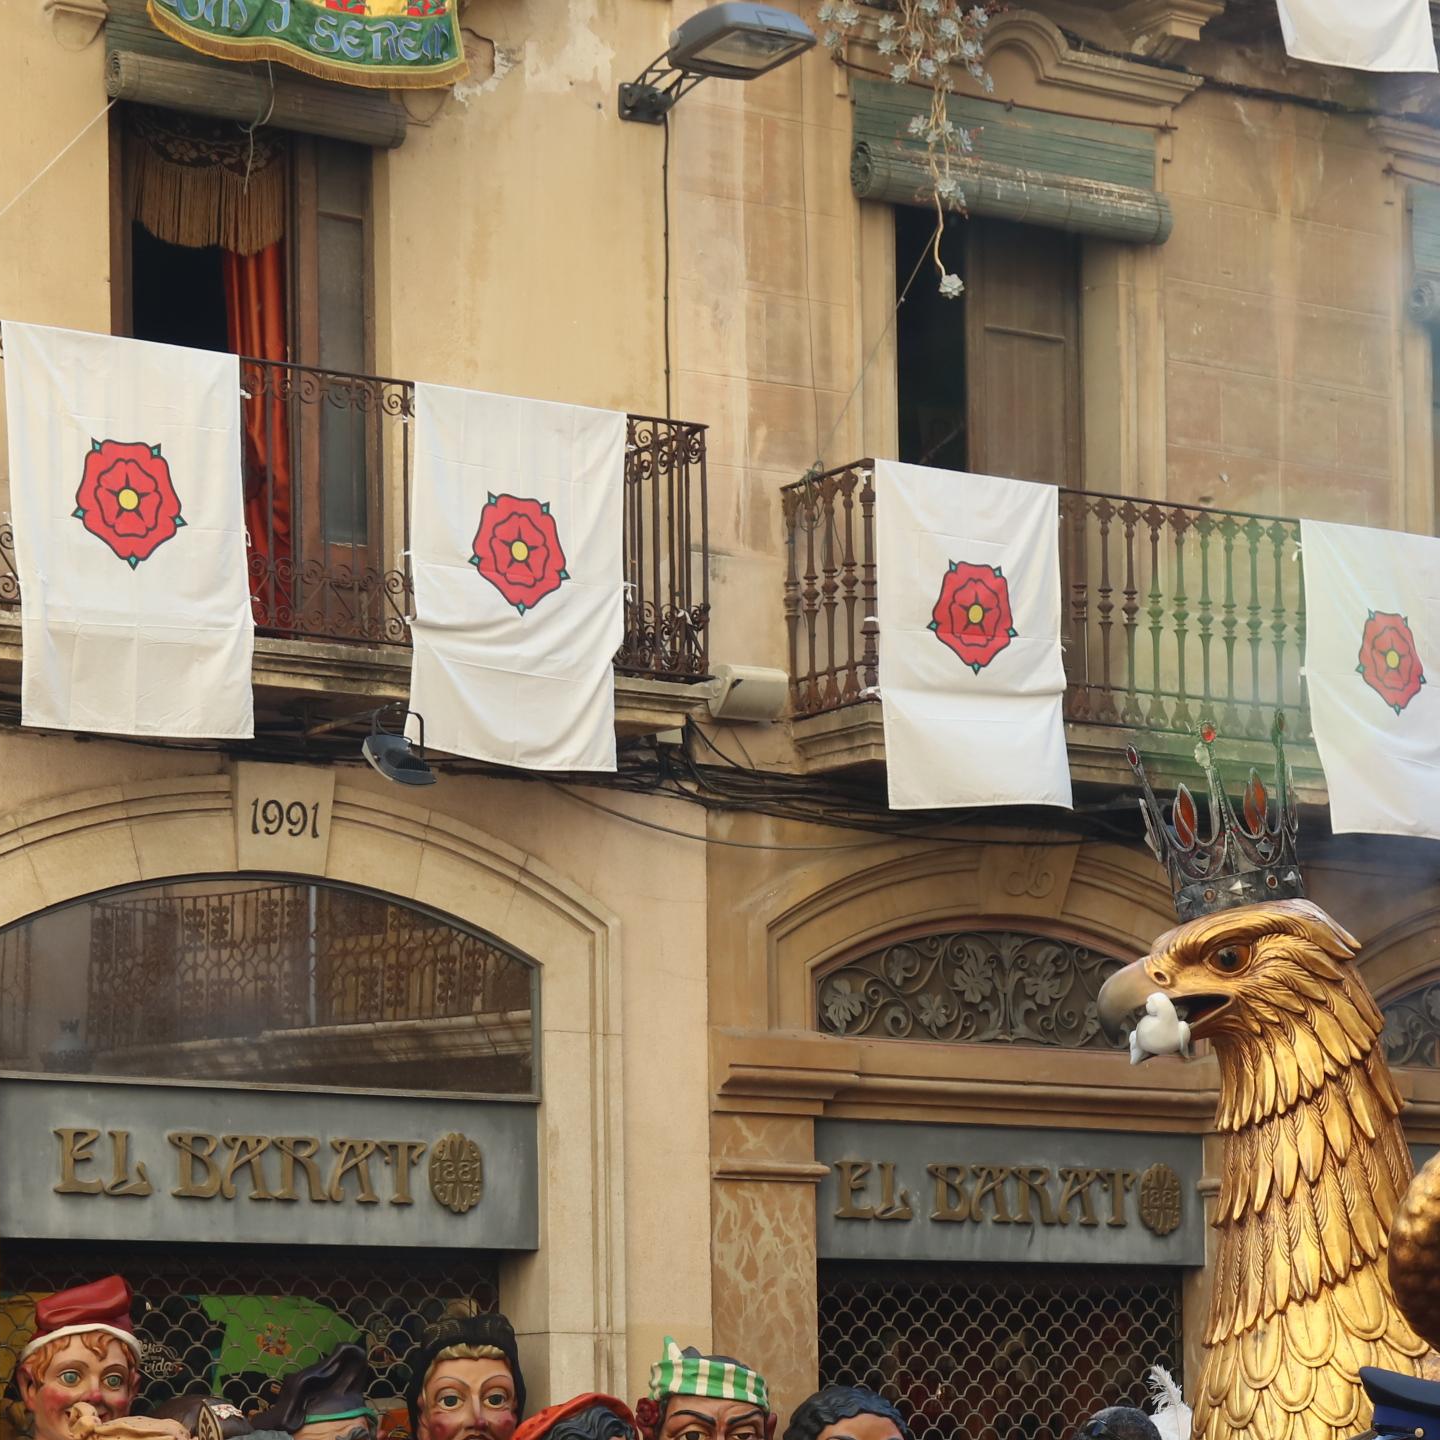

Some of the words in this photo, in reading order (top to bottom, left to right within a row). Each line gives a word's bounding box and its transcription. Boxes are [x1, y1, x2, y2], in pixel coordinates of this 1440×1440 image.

[251, 797, 320, 839] 1991
[54, 1127, 154, 1197] EL
[834, 1159, 912, 1221] EL
